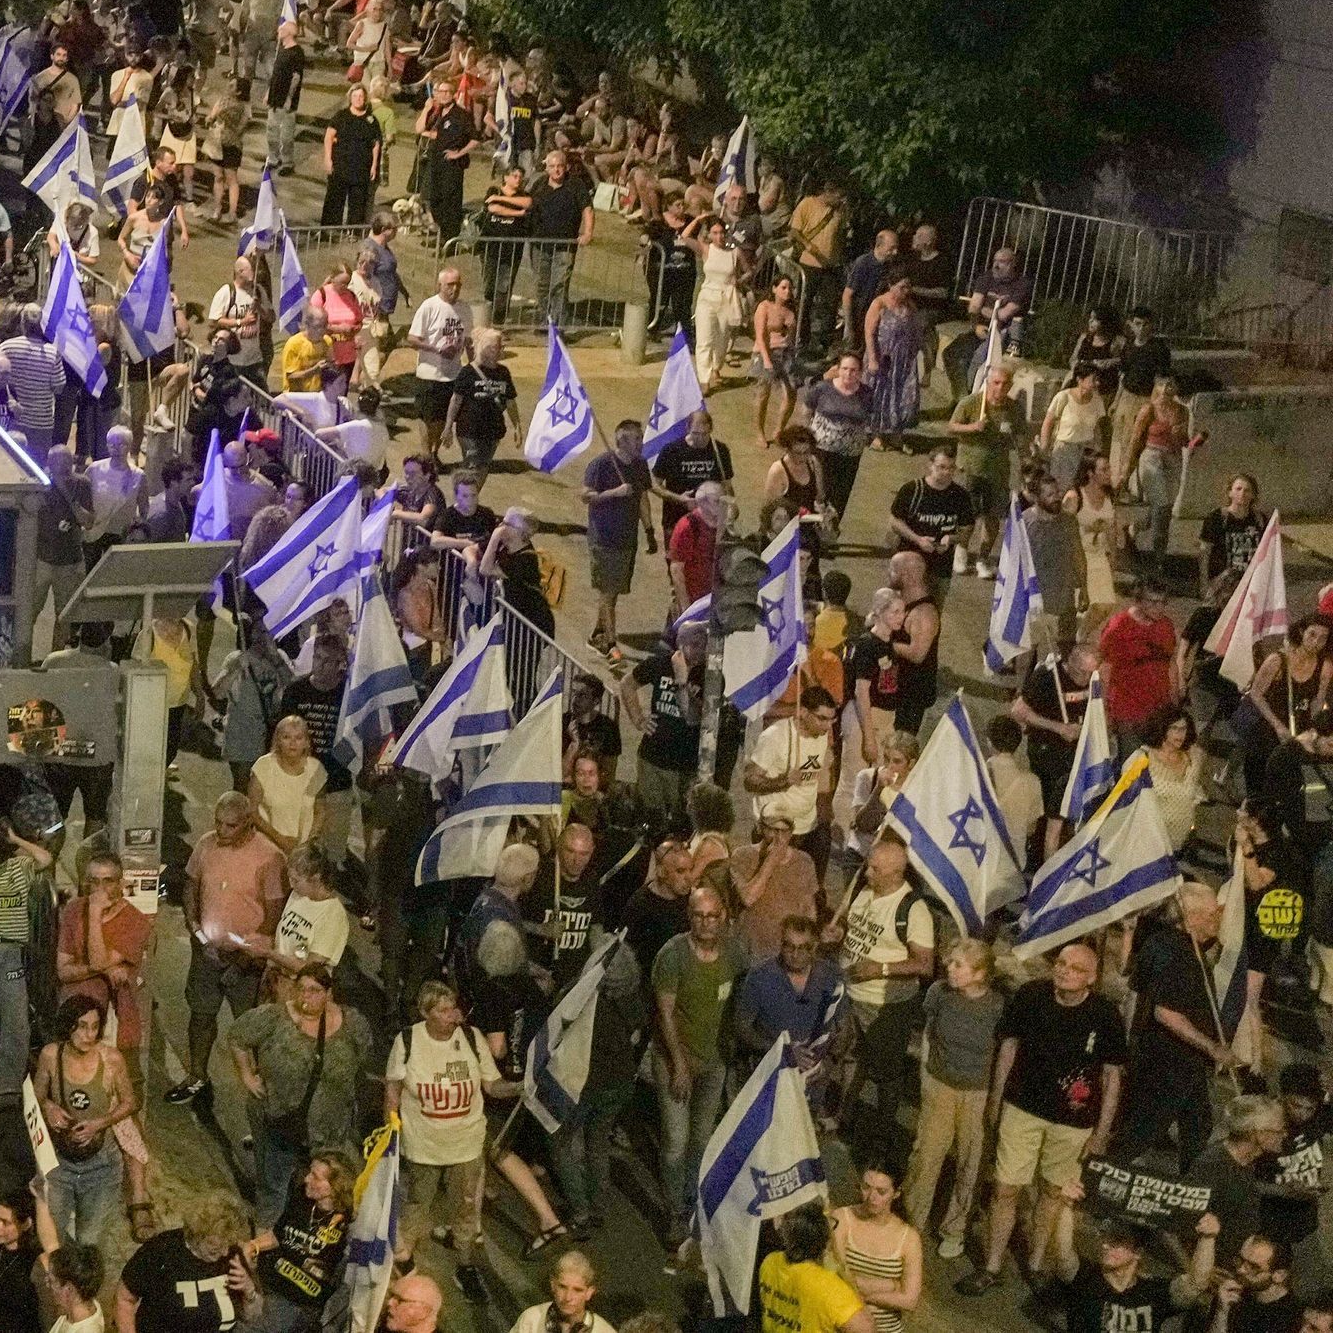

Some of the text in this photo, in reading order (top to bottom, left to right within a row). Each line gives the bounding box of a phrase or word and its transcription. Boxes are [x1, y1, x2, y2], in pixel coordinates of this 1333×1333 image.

[417, 1080, 475, 1110] עכשיו
[1087, 1161, 1212, 1201] במלחמה כולם
[1129, 1187, 1211, 1211] מפסידים
[175, 1274, 236, 1323] די
